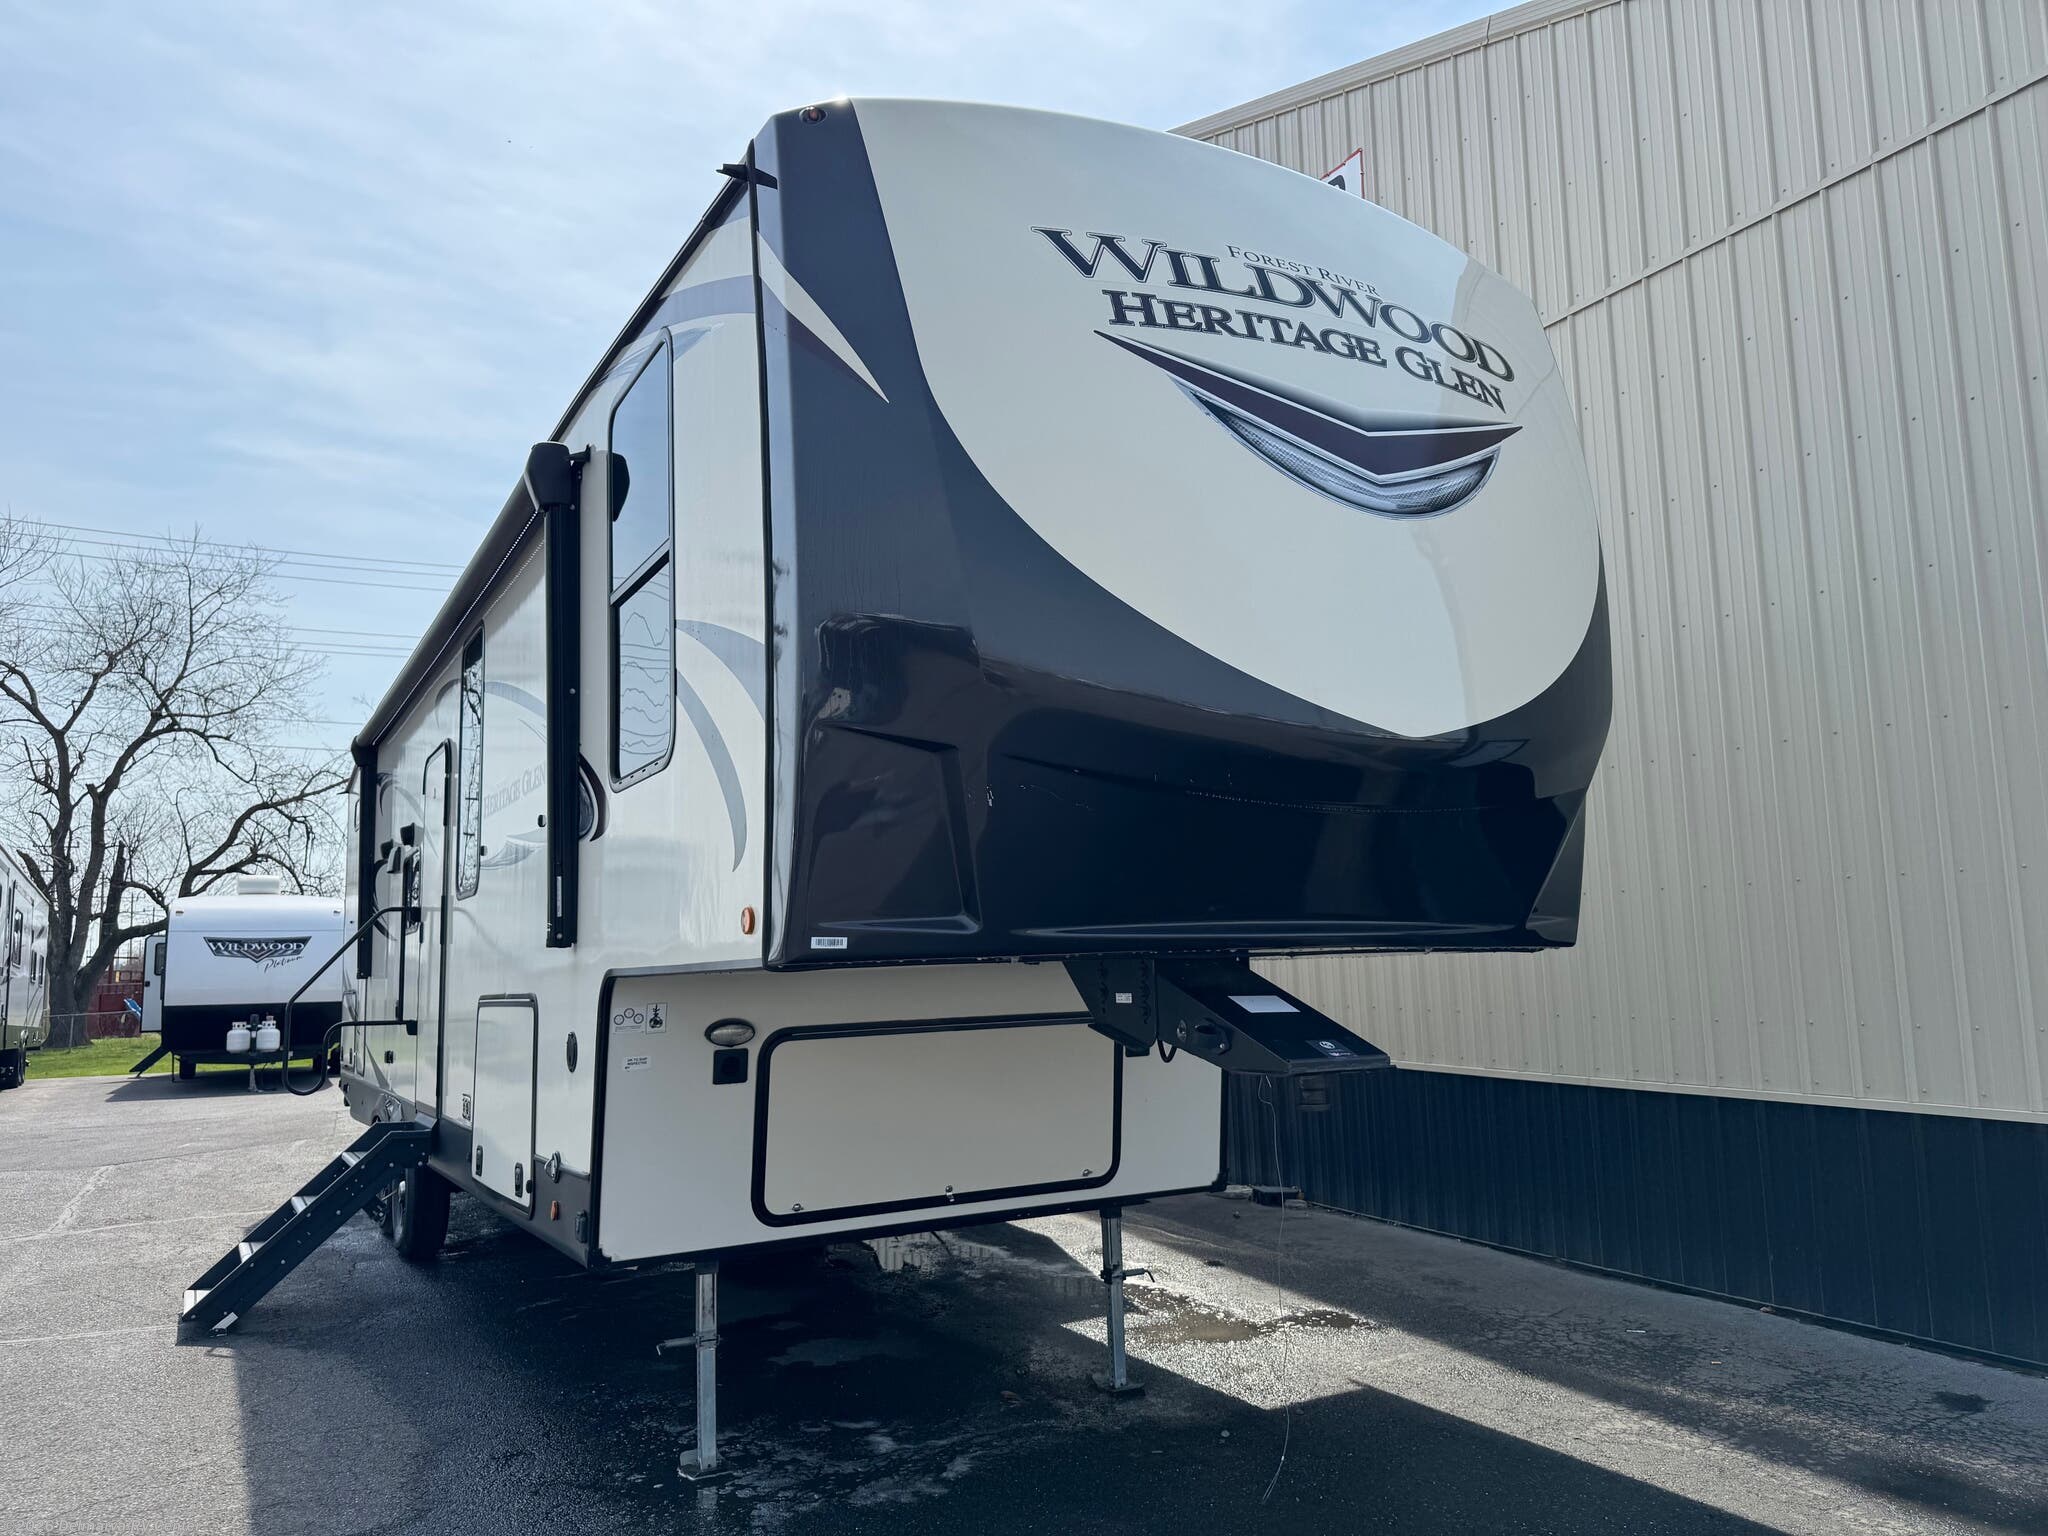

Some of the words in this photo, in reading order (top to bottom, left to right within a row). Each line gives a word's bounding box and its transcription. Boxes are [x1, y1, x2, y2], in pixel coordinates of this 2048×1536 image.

[1031, 226, 1514, 382] WILDWOOD
[1226, 245, 1312, 275] FOREST
[1317, 267, 1381, 298] RIVER
[1101, 289, 1388, 368] HERITAGE
[1395, 346, 1507, 414] GLEN
[208, 942, 305, 952] WILDWOOD
